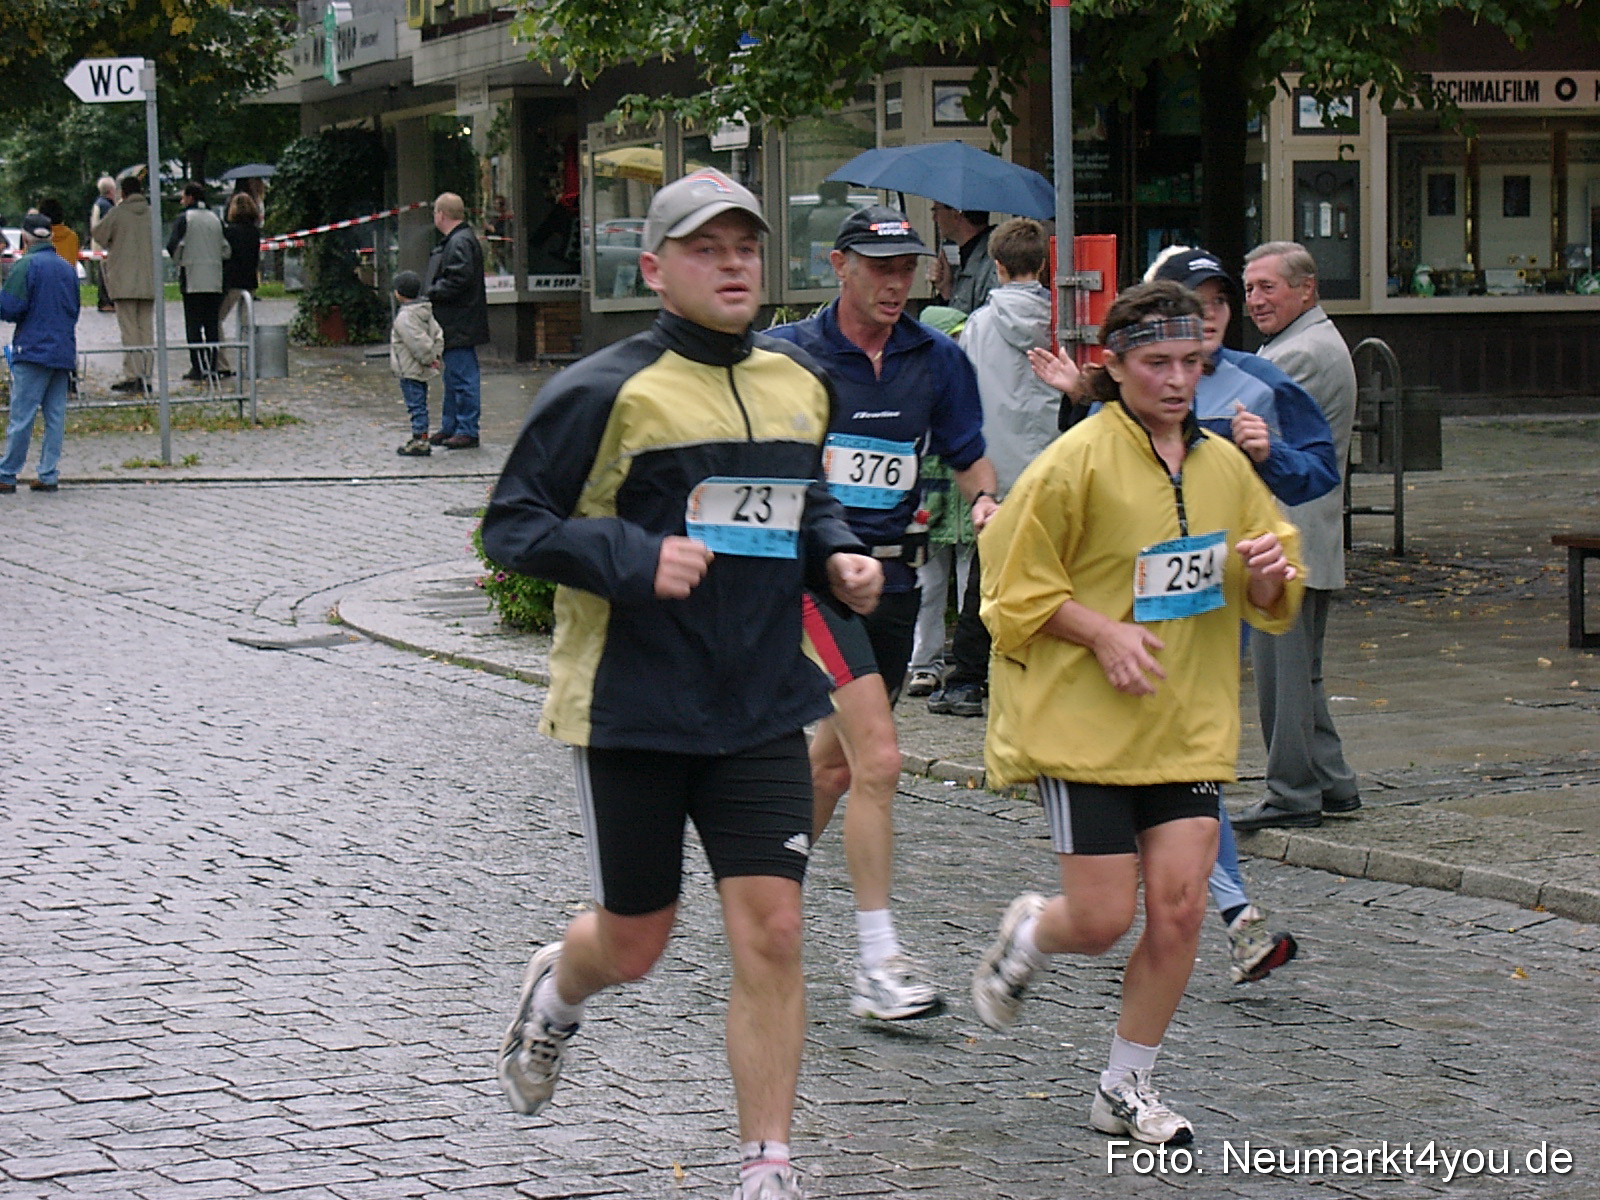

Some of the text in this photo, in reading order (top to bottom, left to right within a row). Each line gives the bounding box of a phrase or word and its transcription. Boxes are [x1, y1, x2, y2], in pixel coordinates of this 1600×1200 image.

[89, 65, 136, 96] WC
[1436, 79, 1540, 102] SCHMALFILM
[553, 278, 576, 288] SHOP
[850, 453, 902, 487] 376
[732, 486, 772, 523] 23
